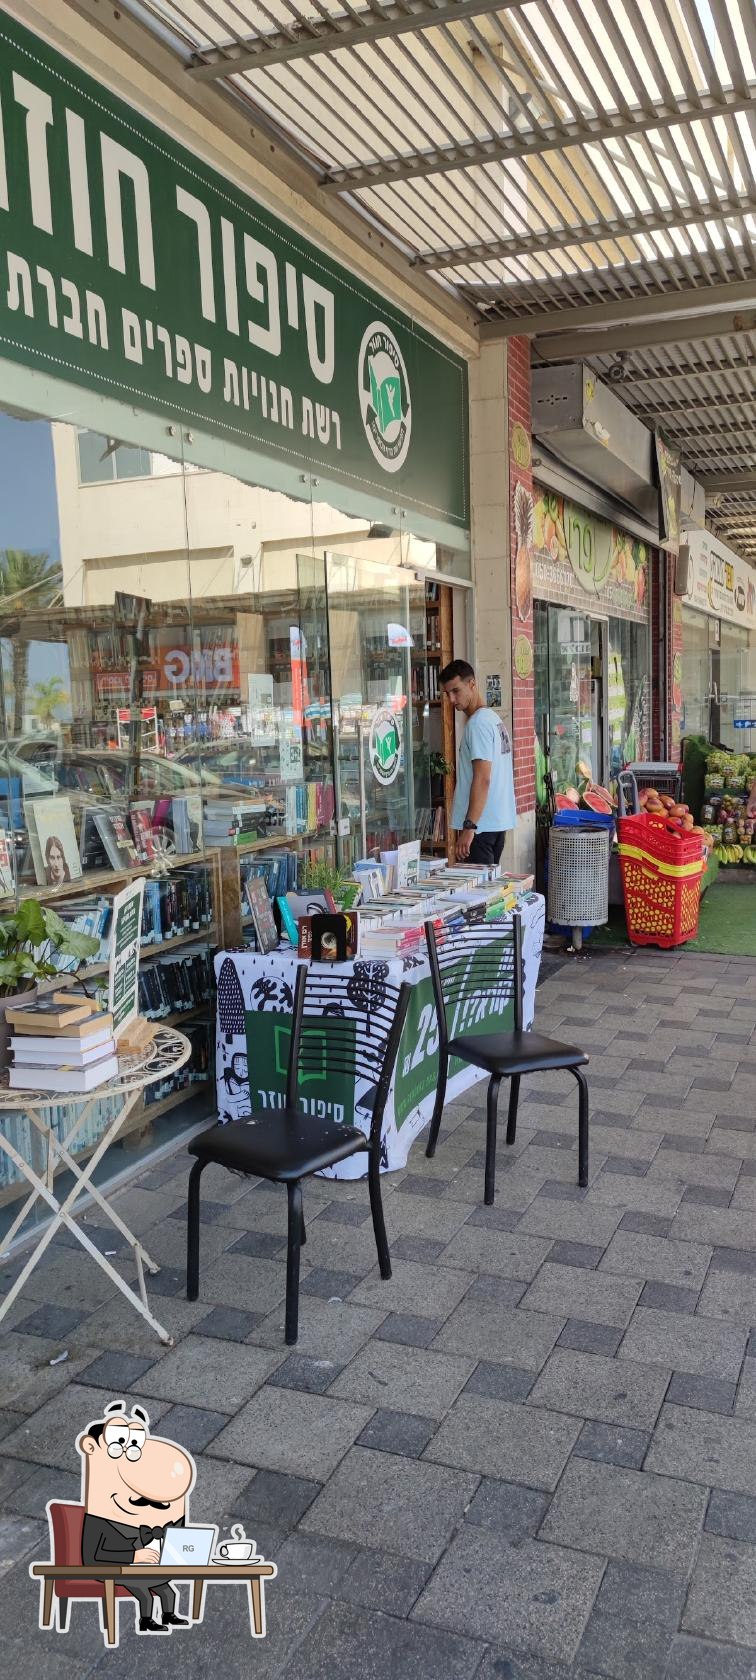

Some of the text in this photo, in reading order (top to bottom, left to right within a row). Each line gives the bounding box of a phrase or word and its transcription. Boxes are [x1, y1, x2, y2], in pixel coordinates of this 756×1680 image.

[0, 71, 335, 384] סיפור חוז
[121, 307, 212, 394] ספרים
[223, 358, 294, 430] חנויות
[302, 396, 341, 450] רשת
[299, 1097, 344, 1123] סיפור
